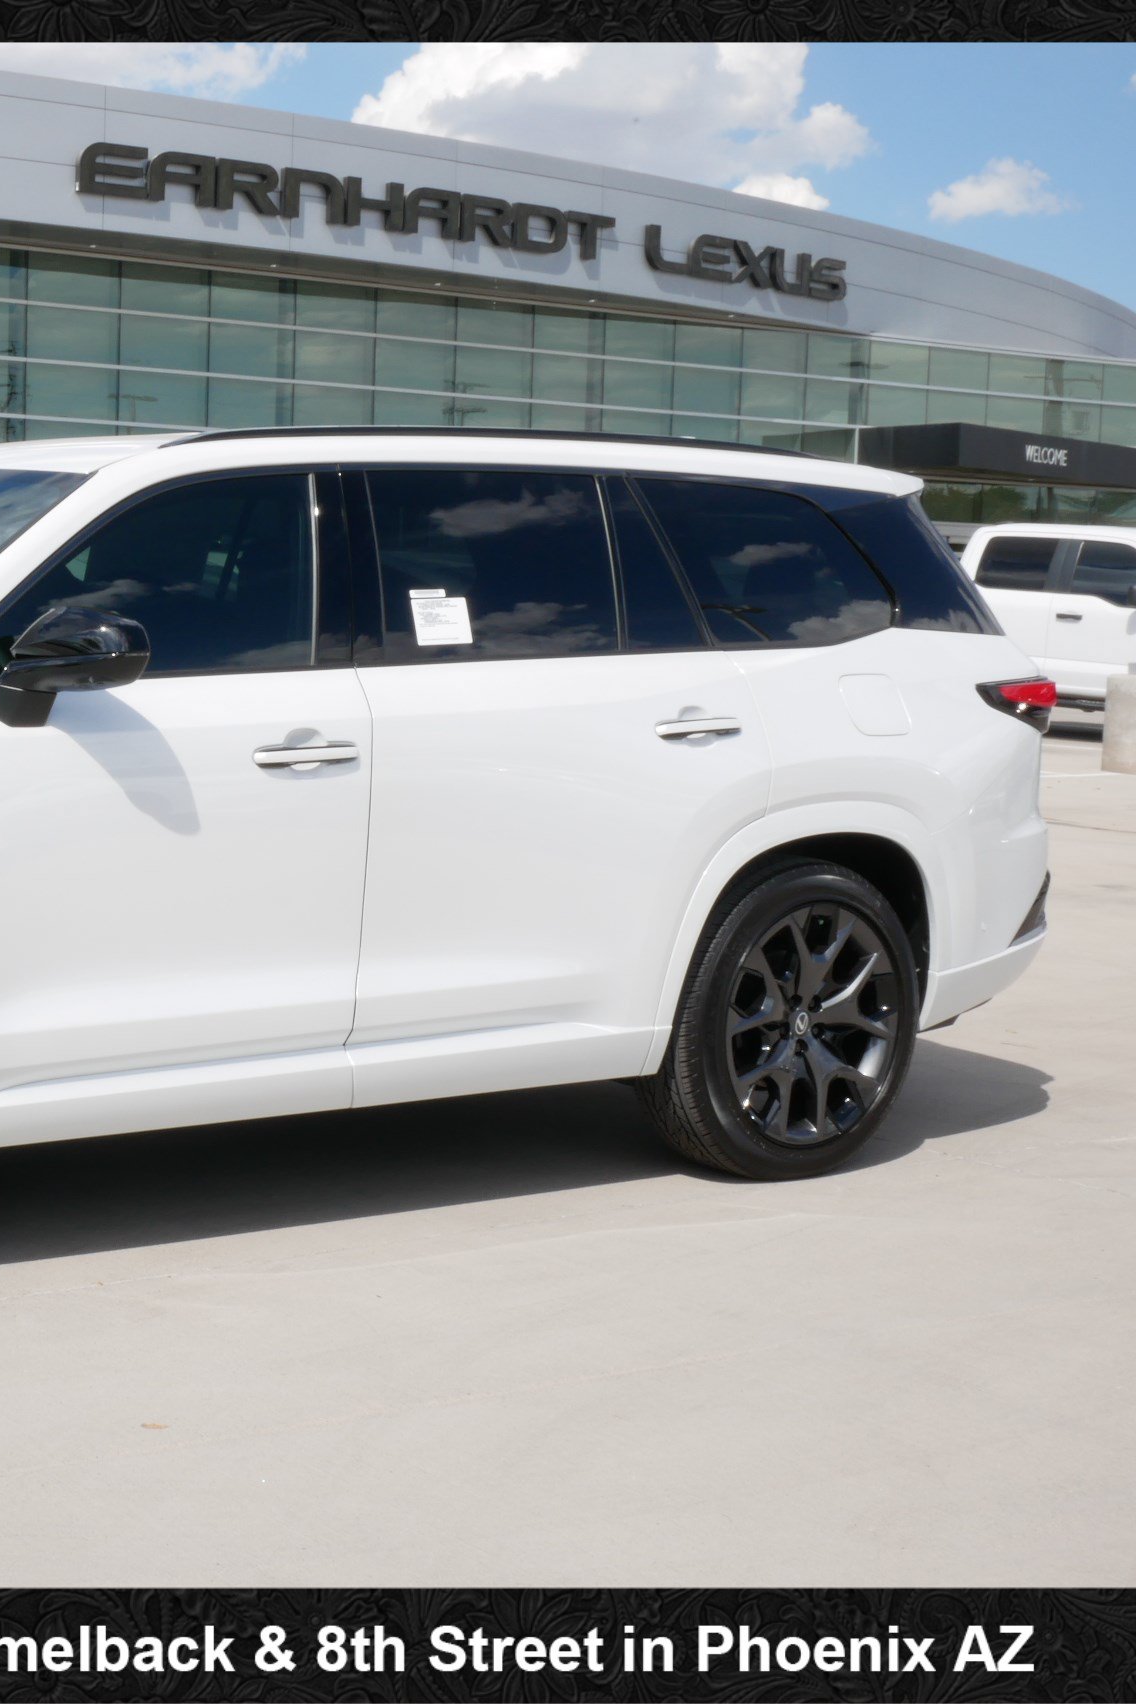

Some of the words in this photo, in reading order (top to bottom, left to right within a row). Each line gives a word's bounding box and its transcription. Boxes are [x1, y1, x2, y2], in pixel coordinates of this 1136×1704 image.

[75, 142, 616, 261] EARNHARDT
[645, 224, 847, 301] LEXUS
[1026, 445, 1068, 467] WELCOME
